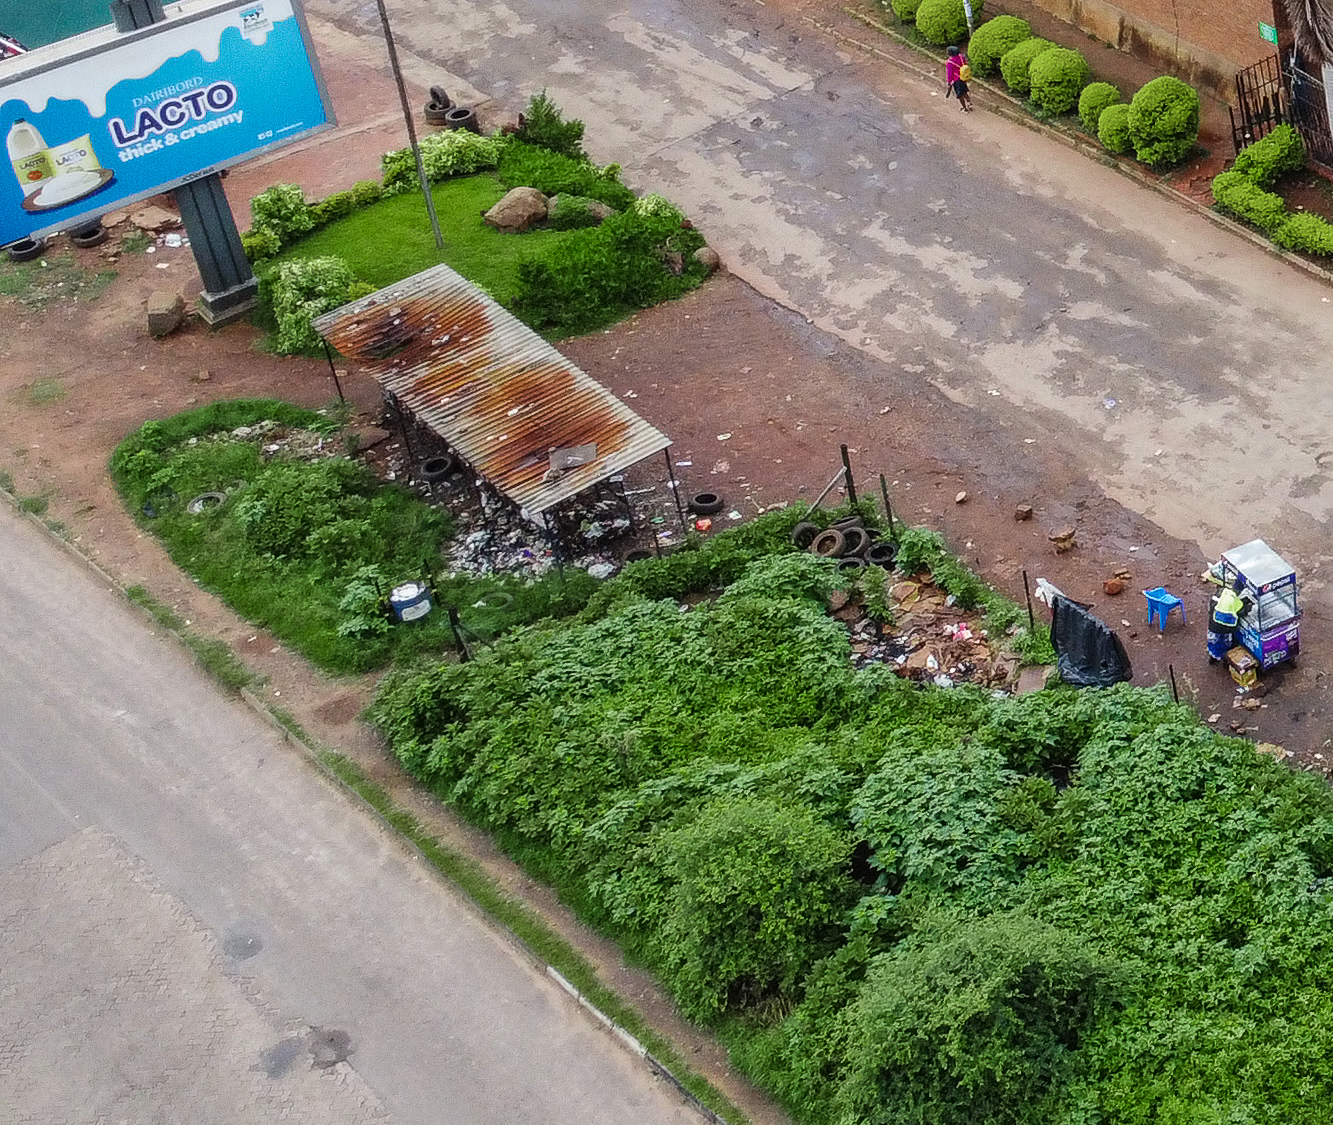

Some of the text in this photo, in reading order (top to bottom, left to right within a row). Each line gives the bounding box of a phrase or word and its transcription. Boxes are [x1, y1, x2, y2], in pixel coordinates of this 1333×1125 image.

[110, 82, 236, 147] LACTO
[132, 76, 204, 108] DAIRIBORD
[118, 110, 243, 162] thick & creamy
